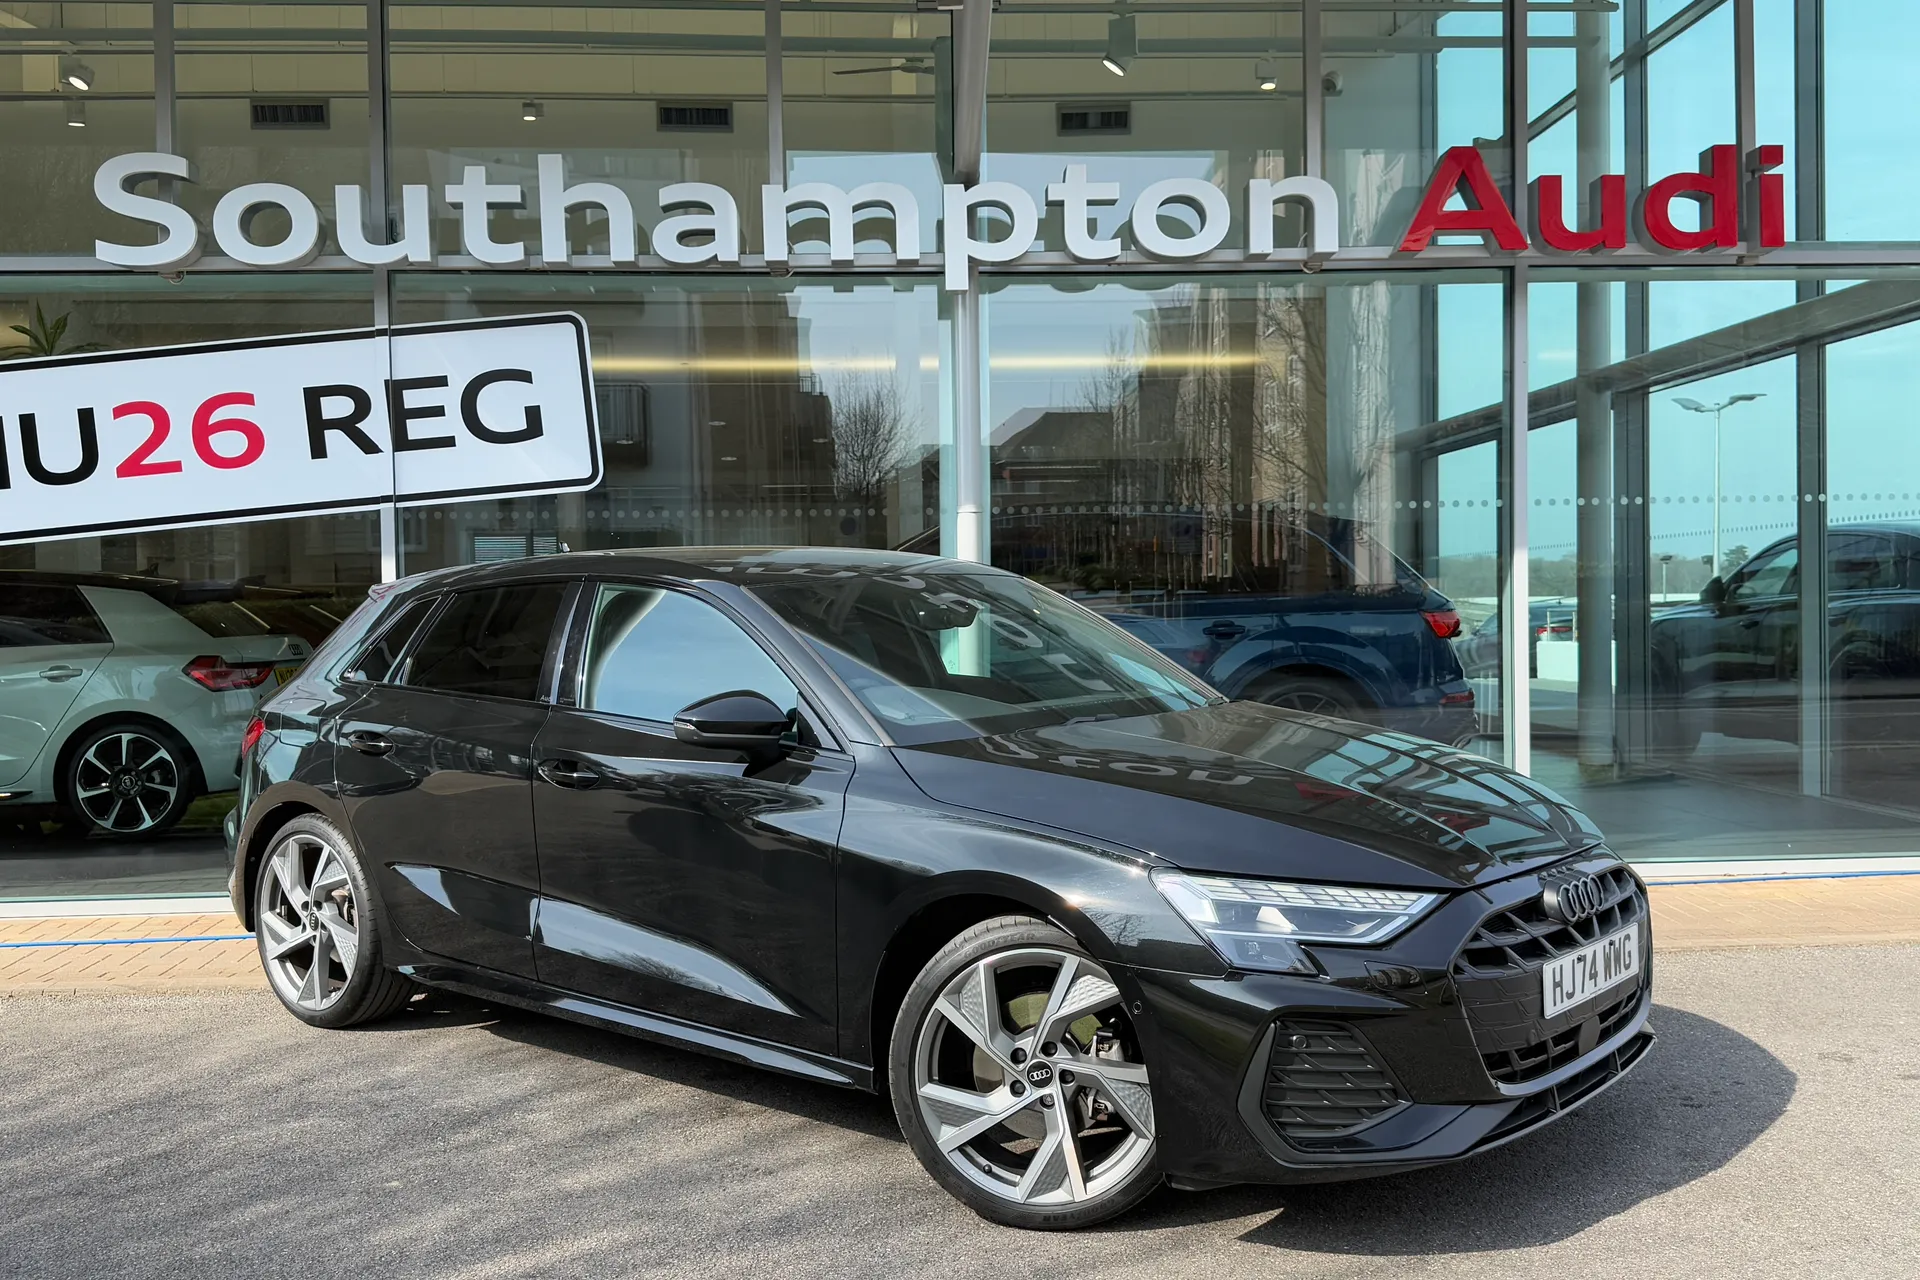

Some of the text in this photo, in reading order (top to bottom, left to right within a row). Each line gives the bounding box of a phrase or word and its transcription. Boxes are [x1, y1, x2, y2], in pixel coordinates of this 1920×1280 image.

[93, 144, 1786, 291] Southampton Audi
[0, 368, 545, 490] U26 REG
[1552, 933, 1632, 1007] HJ74 WWG
